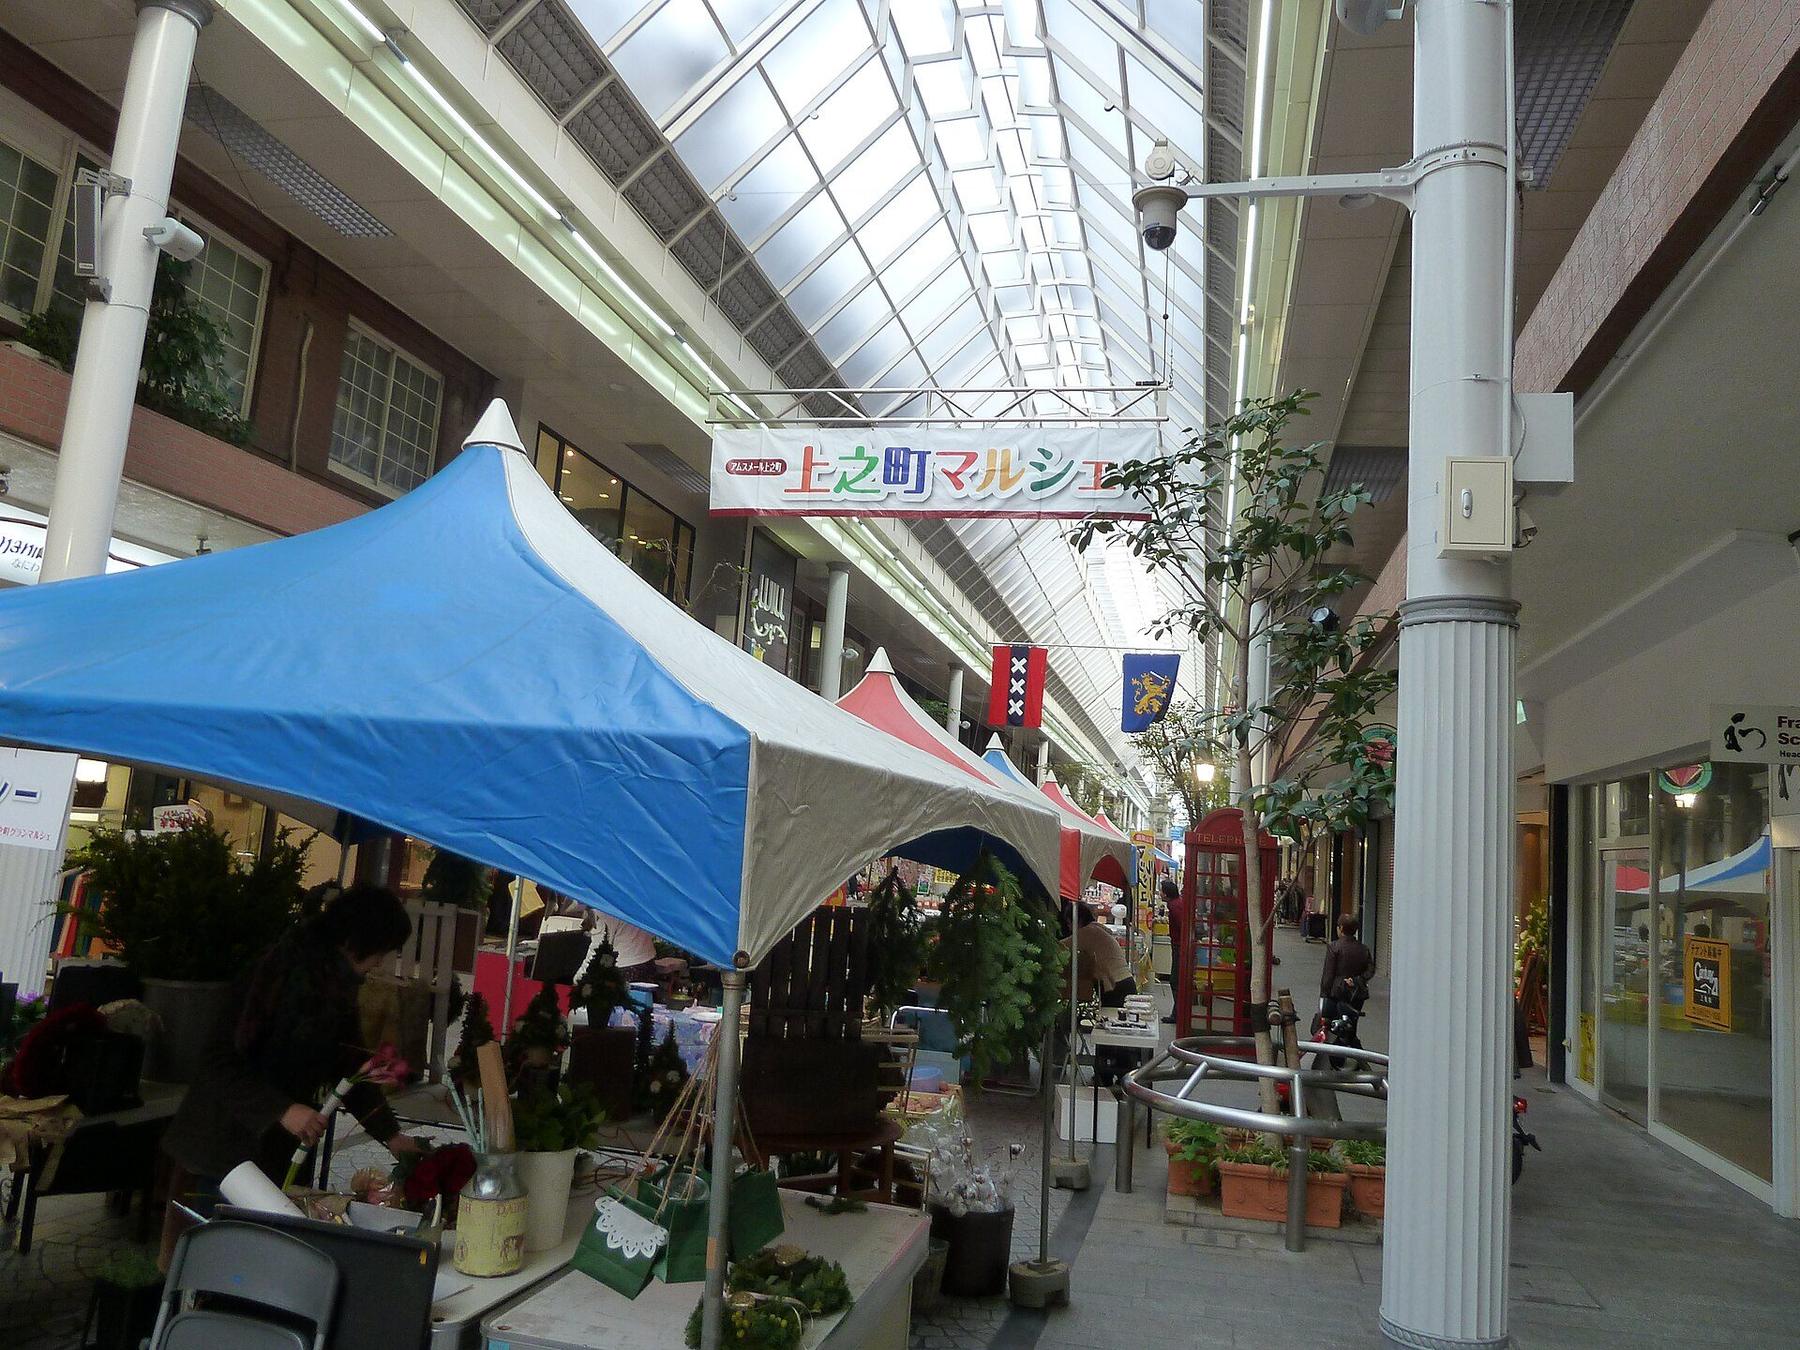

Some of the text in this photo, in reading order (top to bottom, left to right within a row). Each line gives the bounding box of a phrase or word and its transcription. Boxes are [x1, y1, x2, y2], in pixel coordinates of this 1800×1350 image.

[731, 461, 783, 473] アムスメール上之町
[784, 445, 1118, 495] 上之町マルシェ
